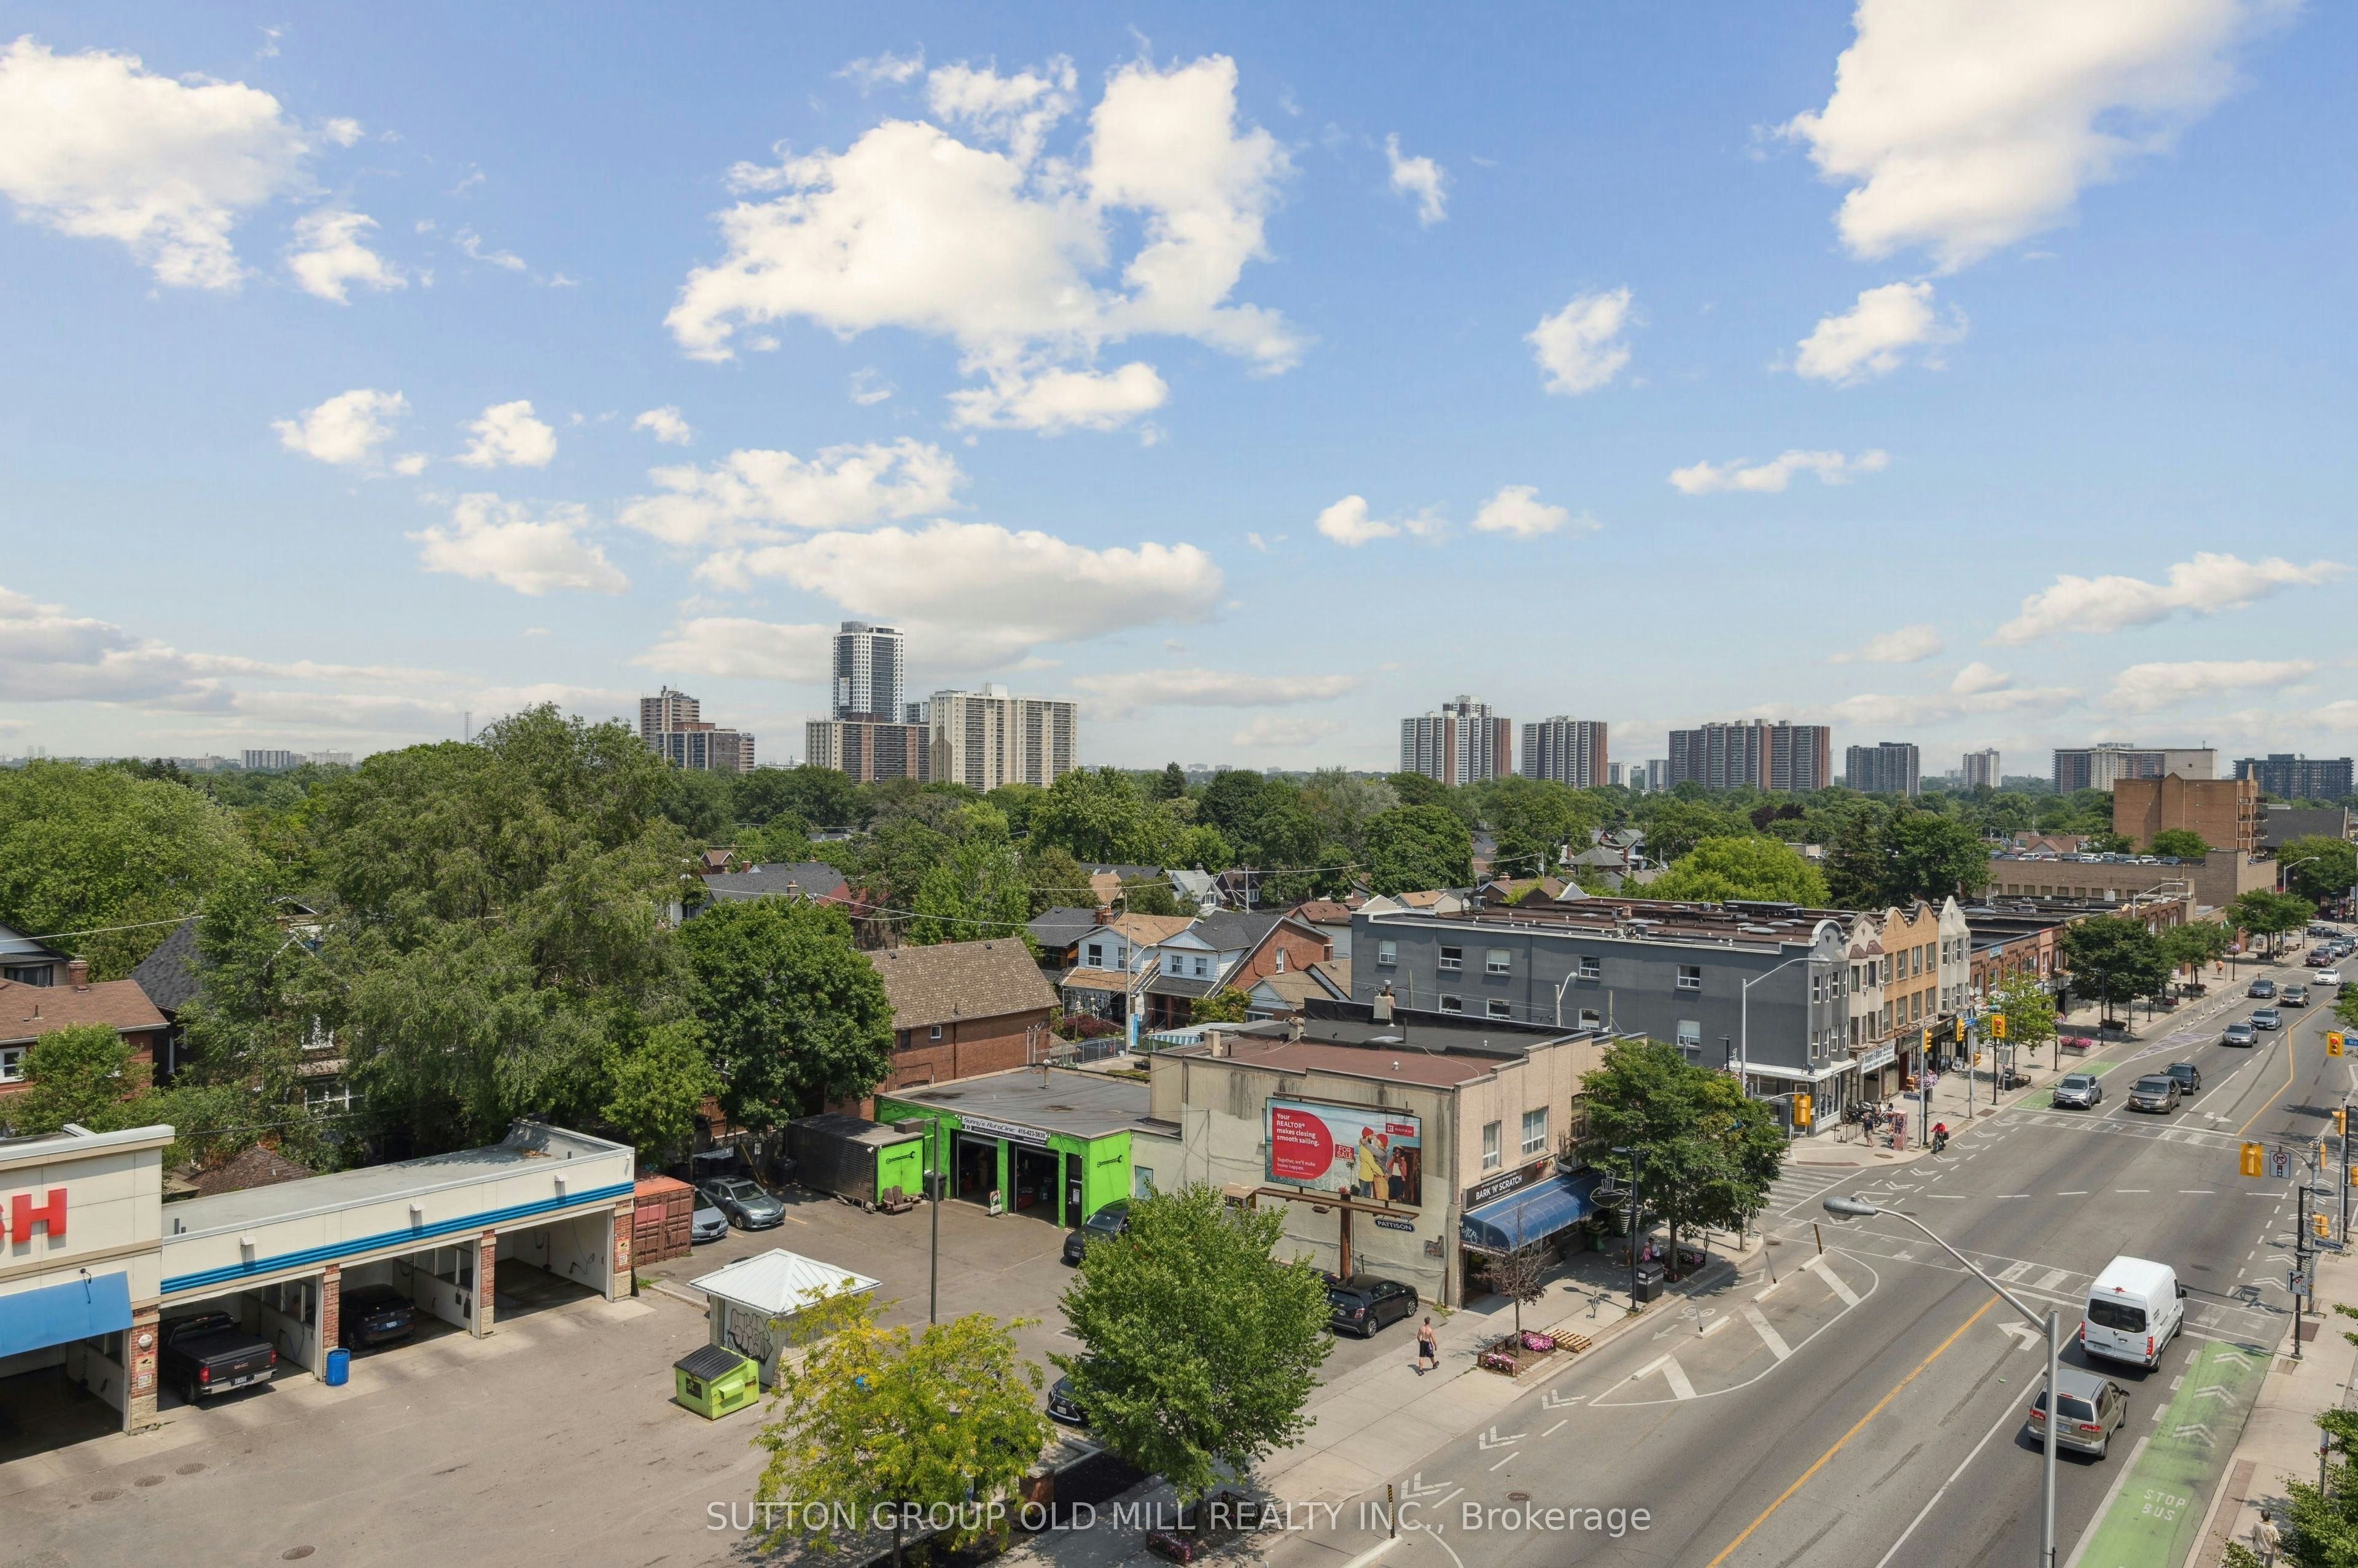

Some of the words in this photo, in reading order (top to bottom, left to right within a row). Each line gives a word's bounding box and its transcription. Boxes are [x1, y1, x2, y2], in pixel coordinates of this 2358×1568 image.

[963, 1117, 985, 1127] Sunny's
[986, 1122, 1016, 1133] AutoClinic
[1018, 1128, 1045, 1139] 416-423-3838
[1296, 1130, 1316, 1139] closing
[1299, 1138, 1320, 1146] sailing.
[1476, 1187, 1490, 1200] BARK
[1499, 1174, 1522, 1190] SCRATCH
[0, 1188, 67, 1243] H
[1377, 1221, 1412, 1231] PATTISON
[2144, 1489, 2186, 1508] STOP
[2141, 1502, 2176, 1521] BUS
